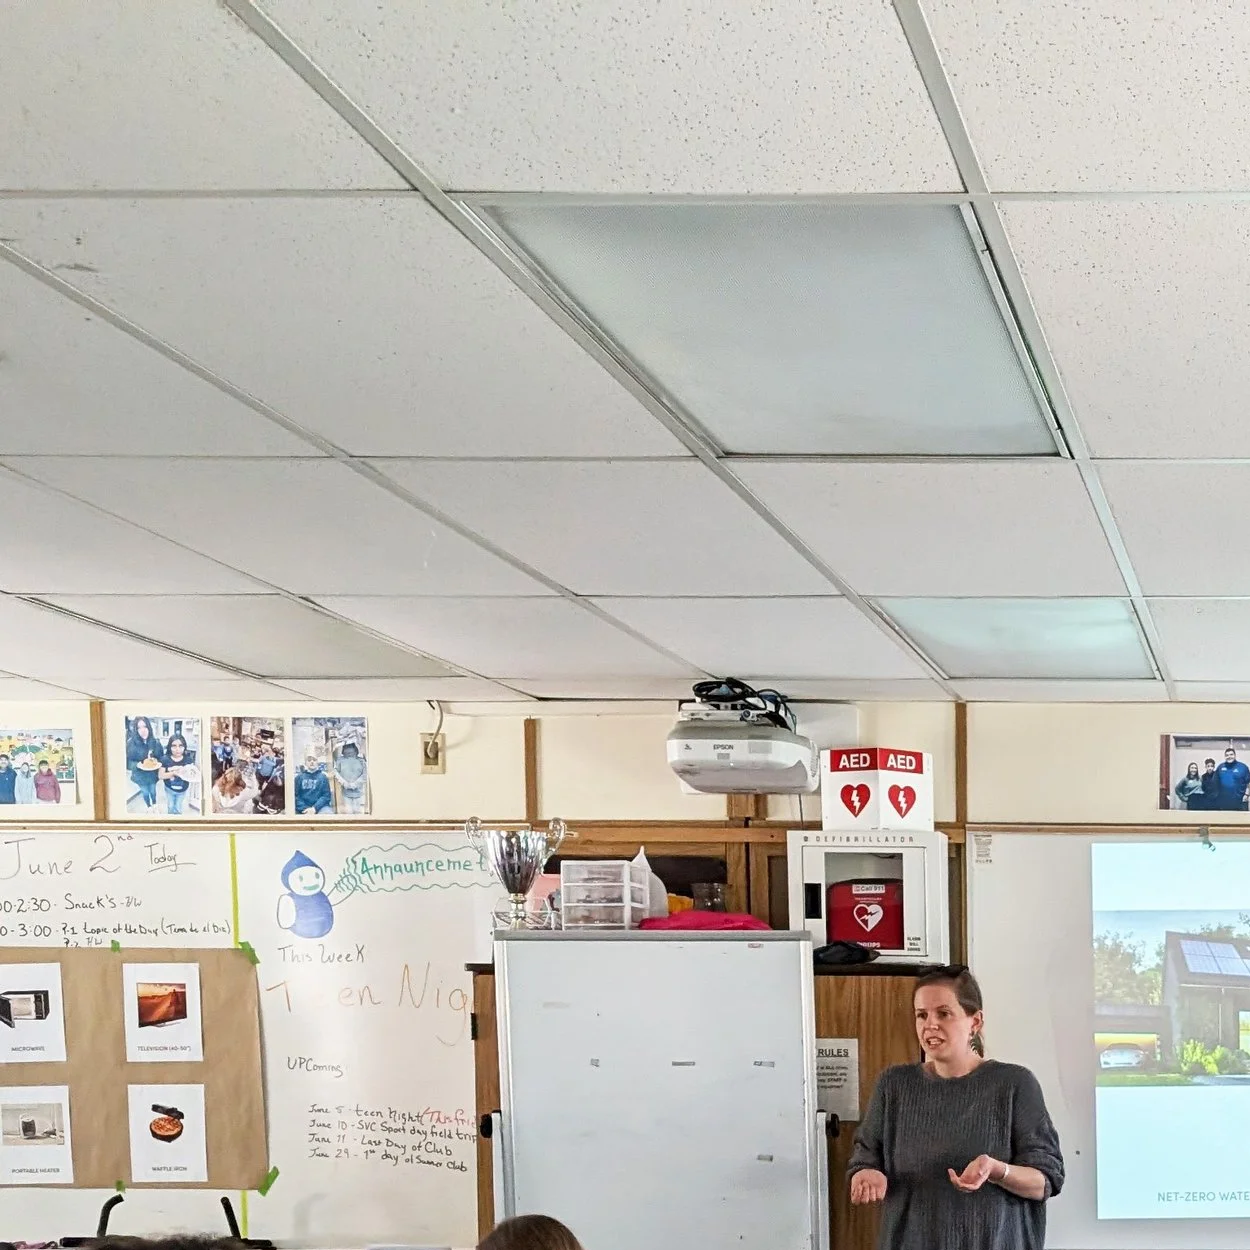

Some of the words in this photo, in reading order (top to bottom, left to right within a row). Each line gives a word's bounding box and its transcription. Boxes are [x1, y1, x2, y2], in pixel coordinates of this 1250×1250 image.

[838, 753, 871, 769] AED
[886, 754, 917, 770] AED
[815, 835, 914, 843] DEFIBRILLATOR
[0, 838, 73, 880] June
[90, 834, 134, 873] 2nd
[144, 842, 178, 872] Today
[277, 945, 313, 962] This
[817, 1048, 849, 1057] RULES
[308, 1104, 331, 1113] June
[353, 1104, 383, 1118] teen
[308, 1119, 332, 1129] June
[424, 1141, 452, 1156] Club
[381, 1149, 398, 1167] day
[446, 1160, 468, 1173] Club
[1157, 1191, 1216, 1203] NET-ZERO
